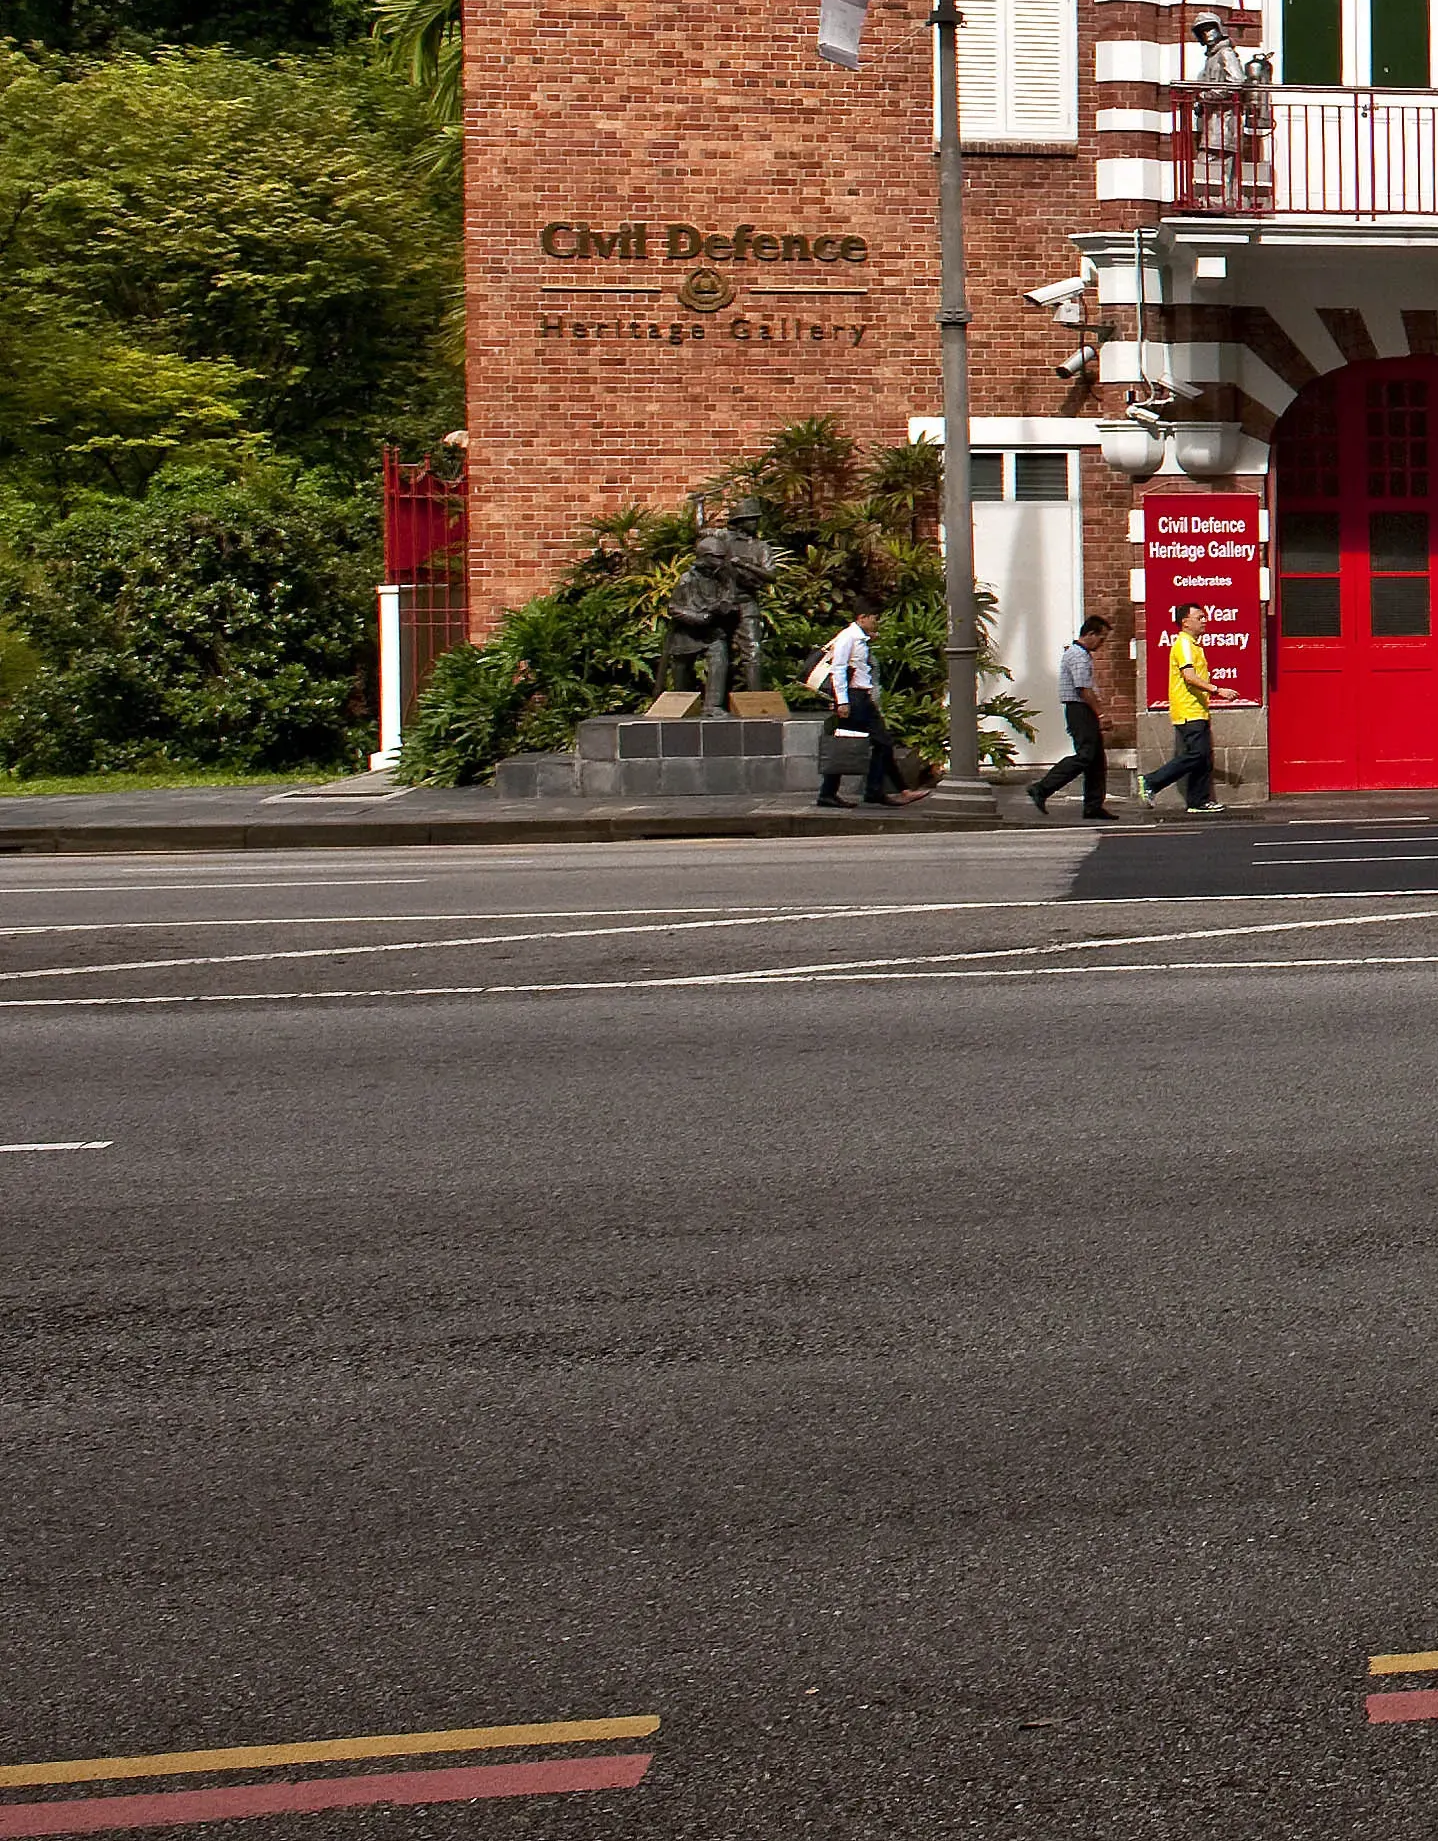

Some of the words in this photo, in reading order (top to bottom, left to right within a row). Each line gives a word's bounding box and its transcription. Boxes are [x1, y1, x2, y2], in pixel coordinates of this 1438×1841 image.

[541, 221, 649, 259] Civil
[667, 224, 868, 262] Defence
[542, 314, 706, 345] Heritage
[732, 317, 868, 347] Gallery
[1158, 517, 1188, 534] Civil
[1191, 517, 1246, 534] Defence
[1149, 541, 1206, 562] Heritage
[1207, 541, 1256, 561] Gallery
[1173, 575, 1233, 587] Celebrates
[1203, 604, 1239, 622] Year
[1211, 667, 1238, 680] 2011
